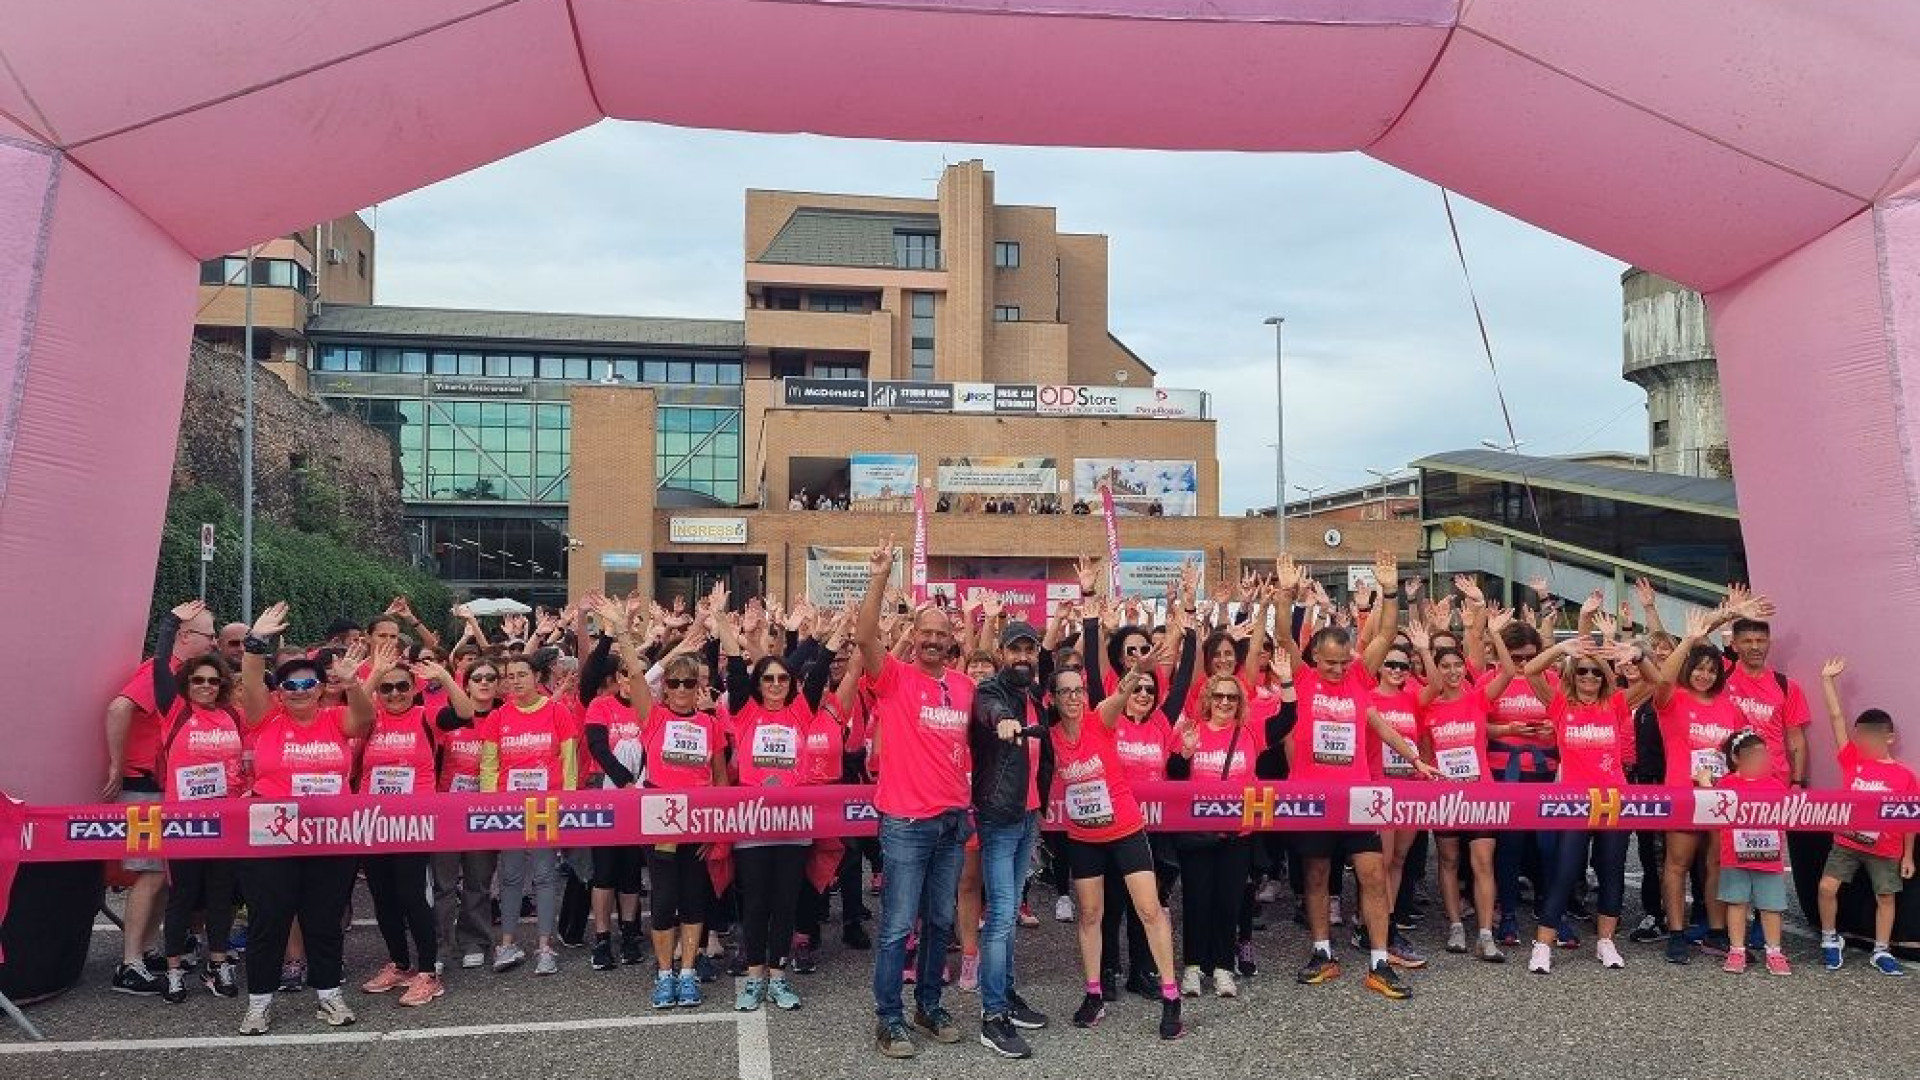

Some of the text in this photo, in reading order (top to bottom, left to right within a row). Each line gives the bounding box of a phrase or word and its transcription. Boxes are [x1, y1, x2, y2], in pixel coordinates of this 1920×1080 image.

[804, 387, 865, 398] McDonald's
[190, 784, 216, 797] 2023
[1193, 786, 1324, 828] FAXHALL
[1394, 790, 1510, 827] STRAWOMAN
[1540, 787, 1668, 829] FAXHALL
[1737, 791, 1852, 828] STRAWOMAN
[70, 805, 219, 852] FAXHALL
[301, 805, 435, 847] STRAWOMAN
[469, 797, 614, 842] FAXHALL
[690, 795, 813, 835] STRAWOMAN
